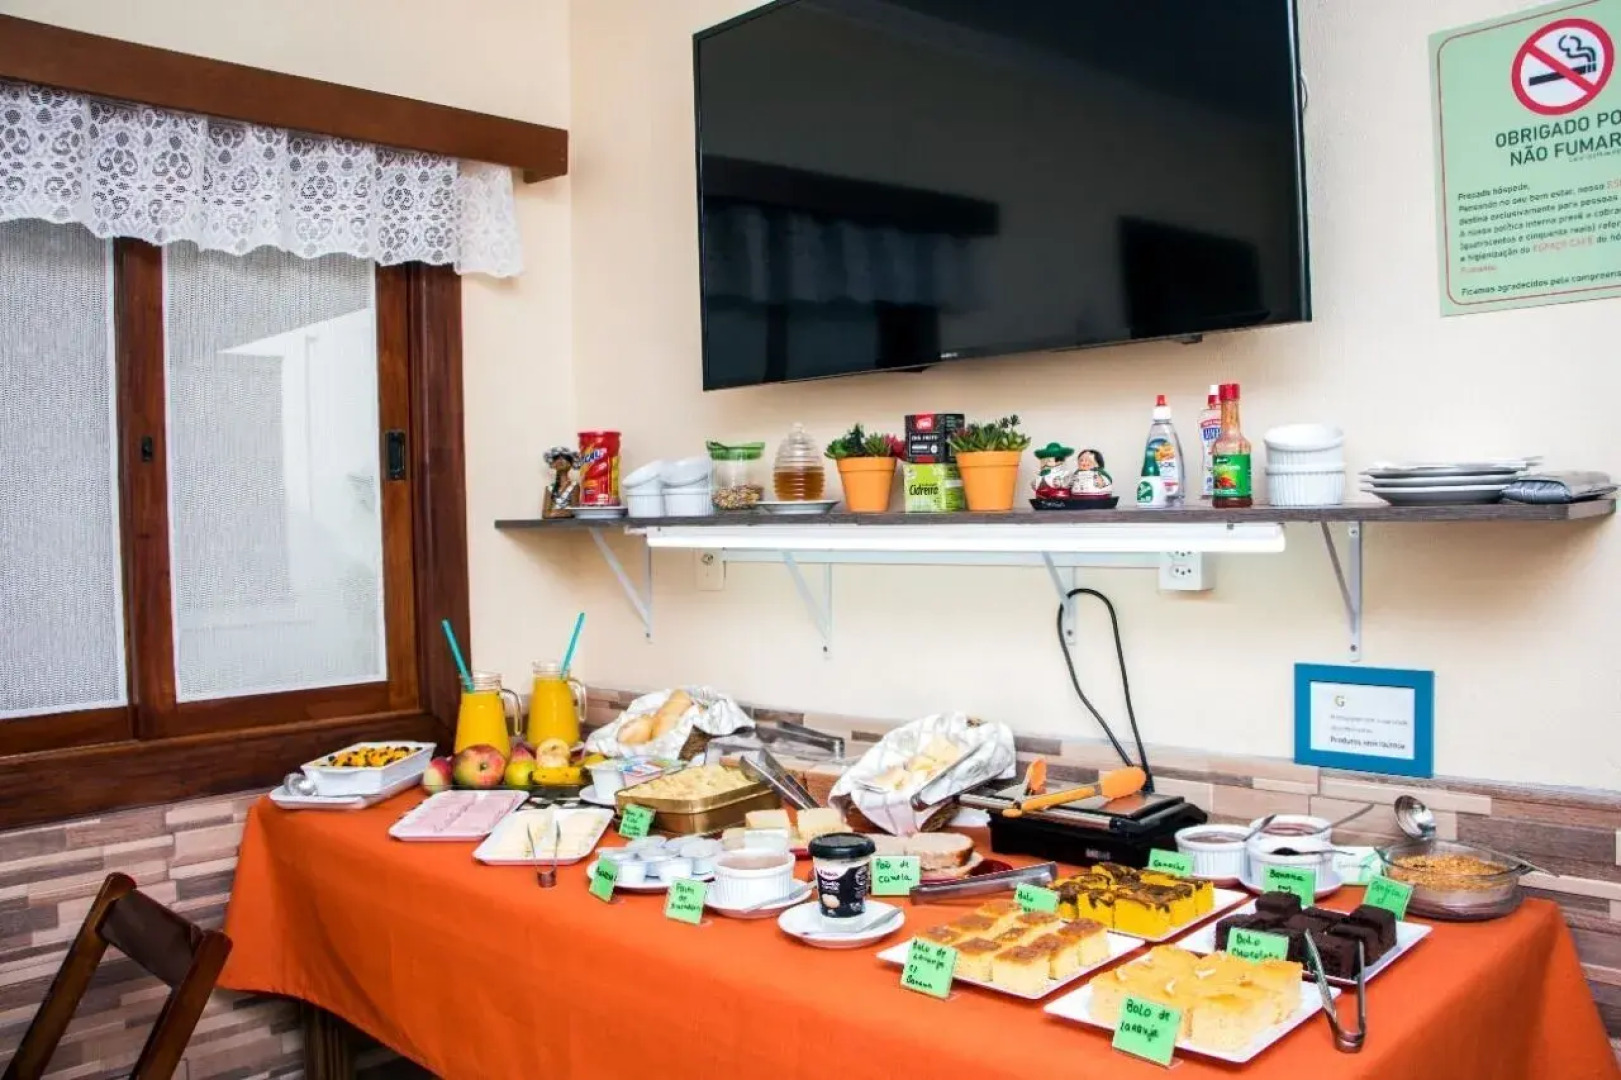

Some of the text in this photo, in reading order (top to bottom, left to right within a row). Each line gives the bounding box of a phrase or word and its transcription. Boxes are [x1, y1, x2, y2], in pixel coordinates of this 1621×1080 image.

[1495, 116, 1590, 148] OBRIGADO
[1510, 146, 1548, 166] NÃO
[1554, 132, 1621, 158] FUMAR
